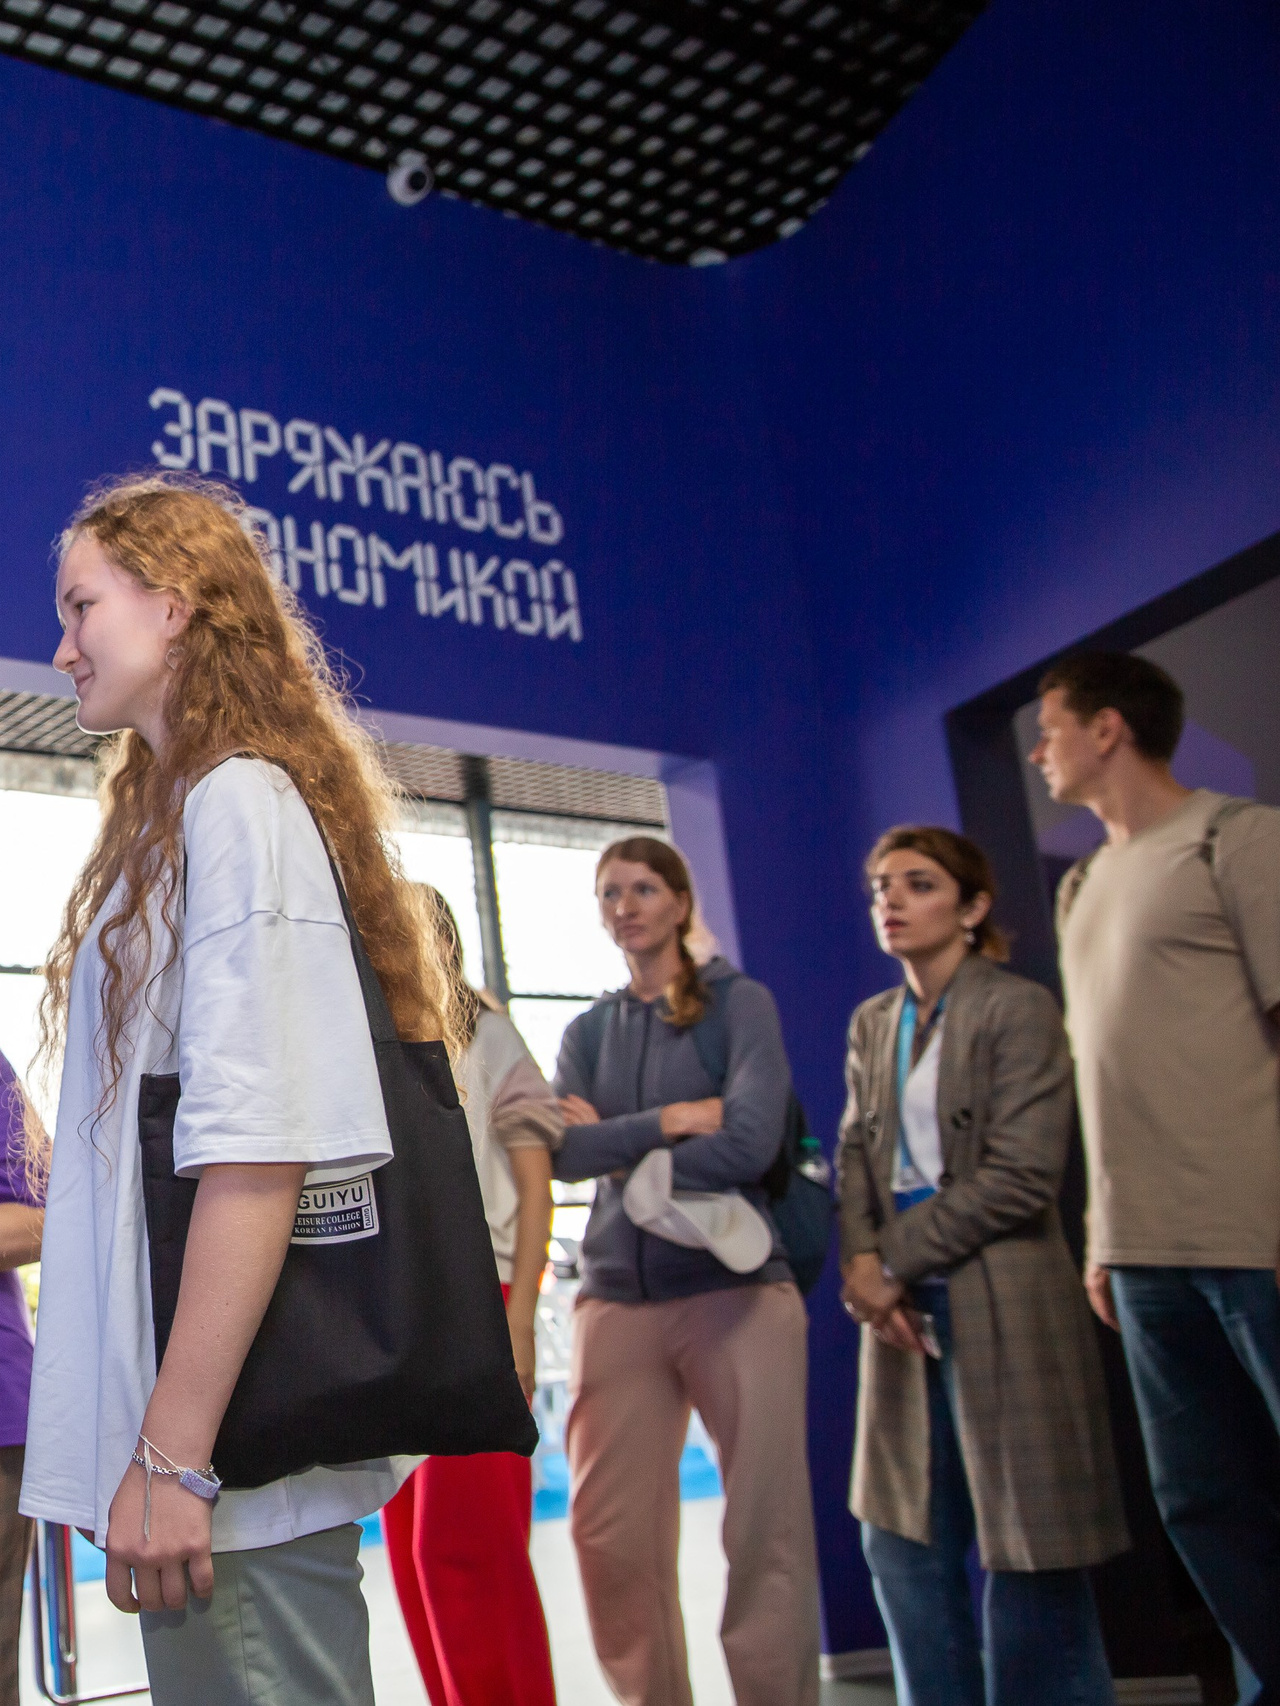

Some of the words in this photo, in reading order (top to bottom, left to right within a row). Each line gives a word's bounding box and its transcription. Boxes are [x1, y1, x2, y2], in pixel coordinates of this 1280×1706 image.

[149, 387, 564, 546] ЗАРЯЖАЮСЬ
[237, 505, 584, 642] ОНОМИКОЙ
[294, 1226, 326, 1235] KOREAN
[328, 1221, 361, 1233] FASHION
[297, 1185, 364, 1210] GUIYU
